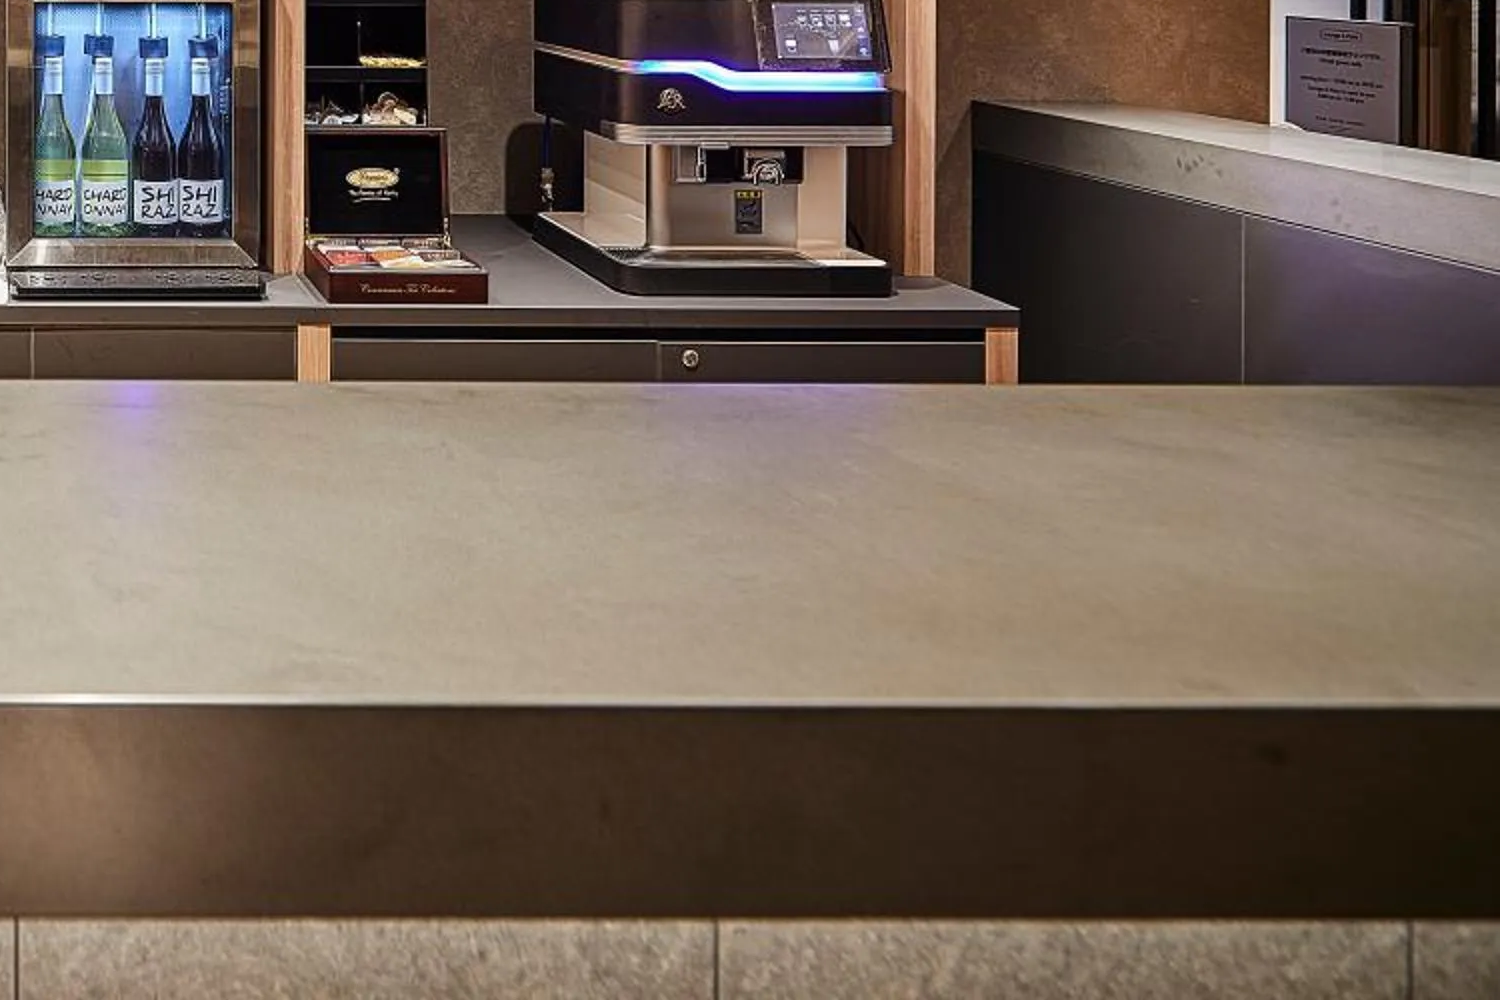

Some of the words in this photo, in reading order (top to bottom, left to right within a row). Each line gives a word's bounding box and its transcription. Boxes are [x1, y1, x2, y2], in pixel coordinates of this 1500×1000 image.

[36, 187, 73, 202] HARD
[141, 186, 175, 203] SHI
[182, 186, 217, 203] SHI
[142, 204, 177, 219] RAZ
[182, 203, 219, 218] RAZ
